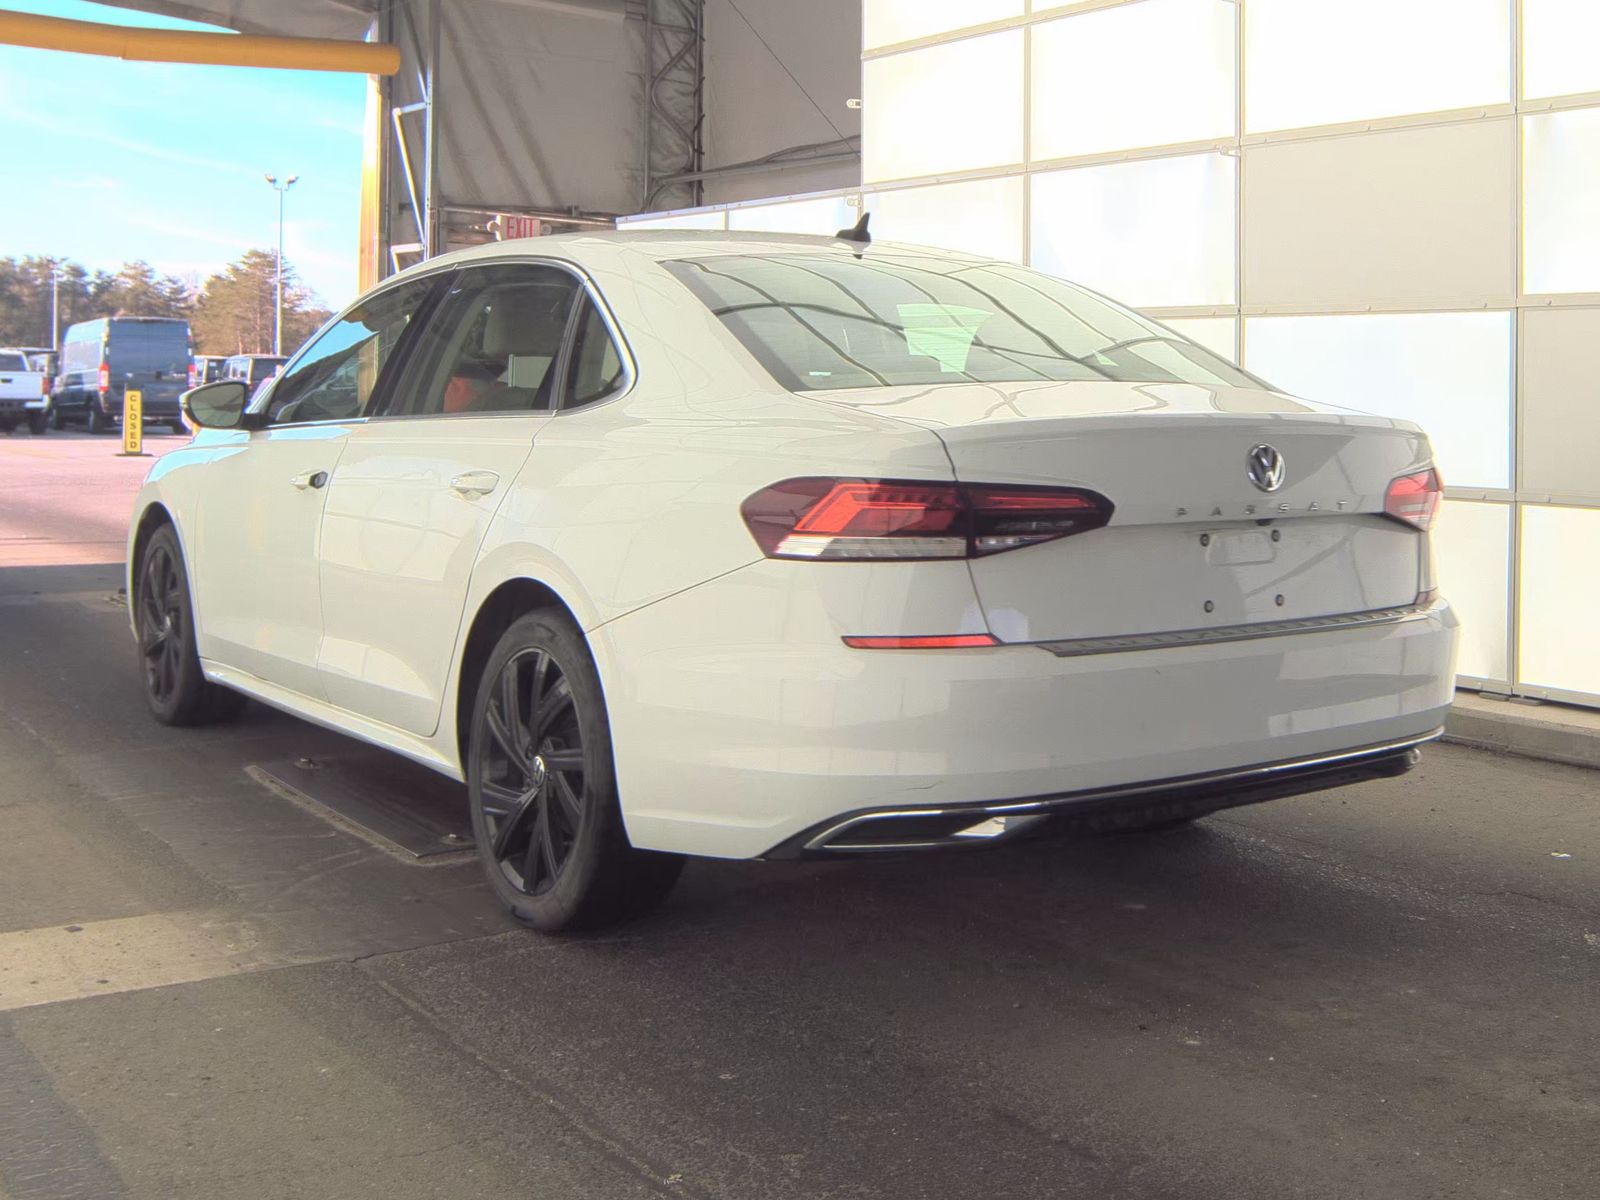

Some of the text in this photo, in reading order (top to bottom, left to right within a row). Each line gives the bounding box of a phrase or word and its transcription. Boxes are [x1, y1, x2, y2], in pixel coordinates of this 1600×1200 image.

[506, 216, 535, 239] EXIT
[129, 394, 138, 449] CLOSED
[1176, 501, 1348, 517] PASSAT
